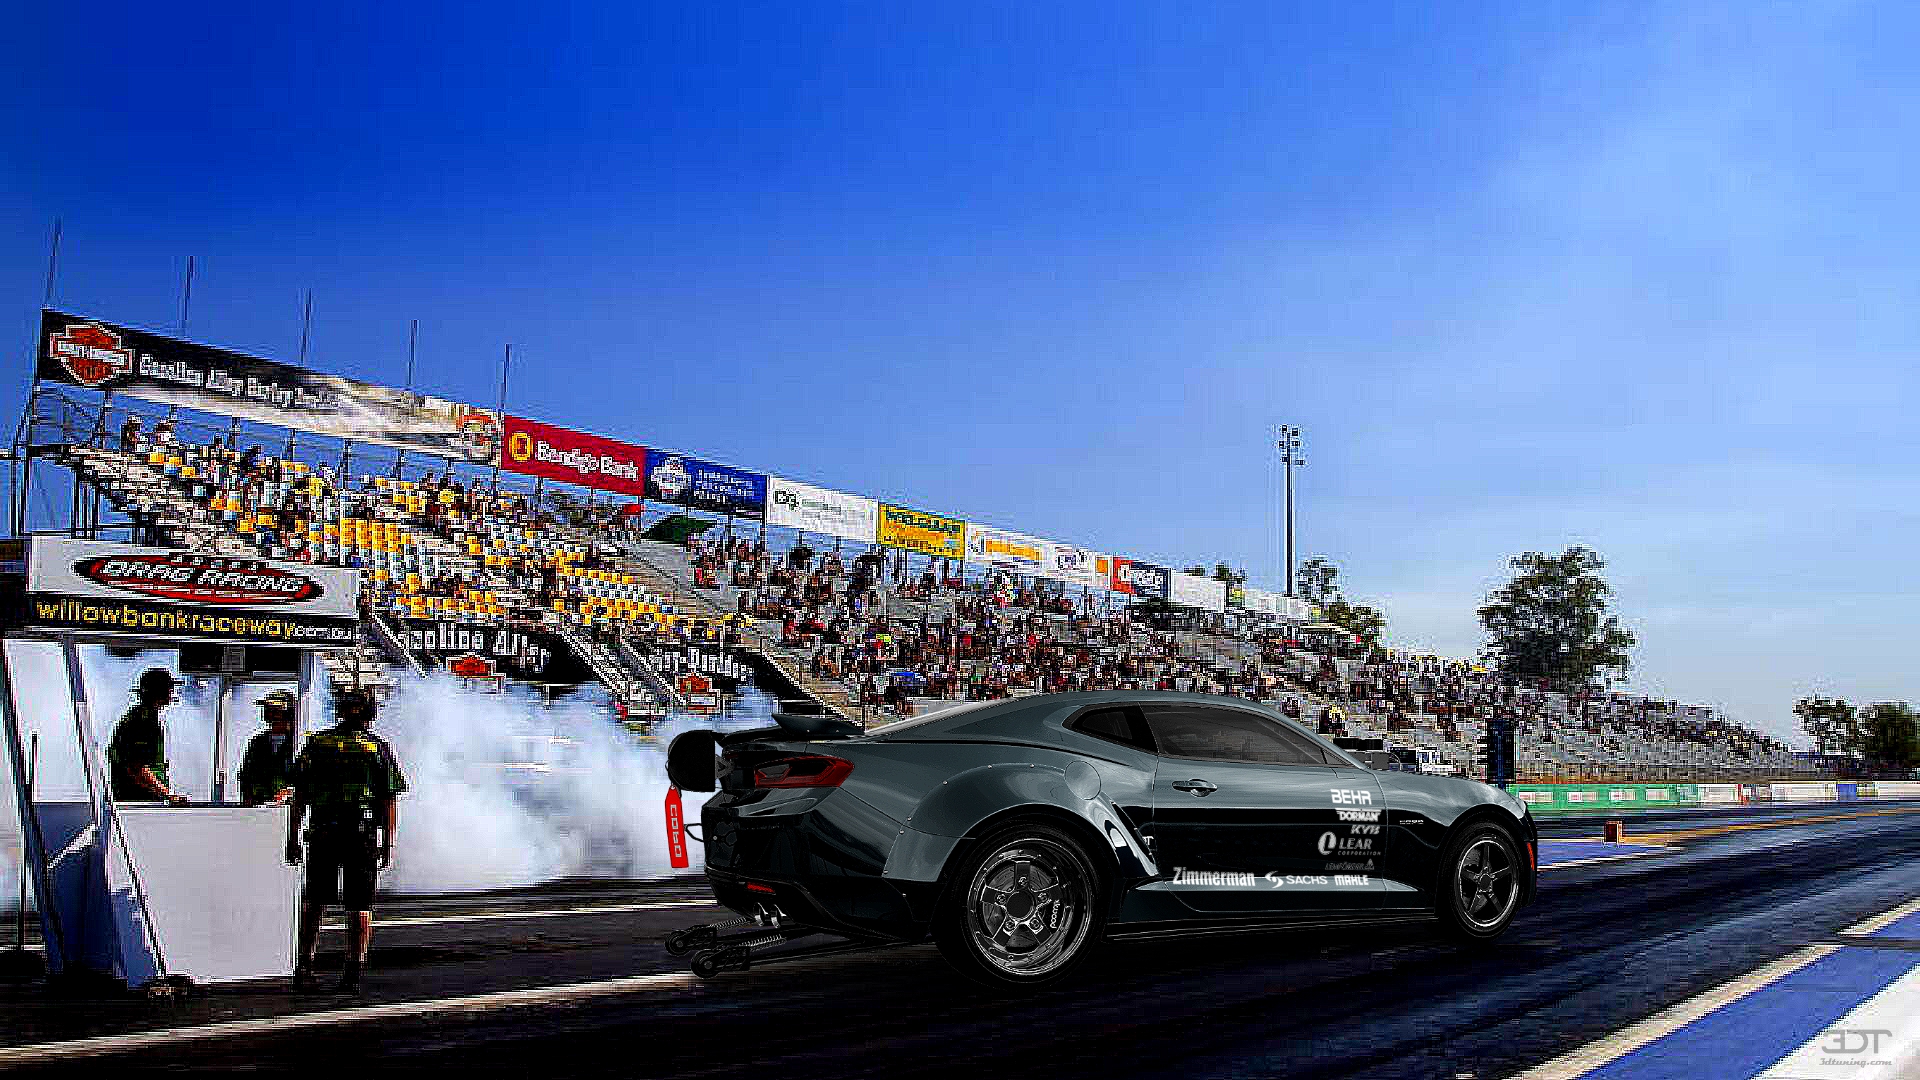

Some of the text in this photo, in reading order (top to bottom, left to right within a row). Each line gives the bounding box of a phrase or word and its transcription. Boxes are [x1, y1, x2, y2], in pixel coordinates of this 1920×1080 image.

[537, 440, 599, 474] Bendigo
[600, 456, 639, 482] Bank
[102, 562, 193, 582] DRAG
[197, 570, 305, 592] RACING
[1330, 788, 1372, 805] BEHR
[1336, 810, 1381, 822] DORMAN
[1350, 824, 1381, 835] KYB
[1339, 837, 1373, 850] LEAR
[1172, 866, 1369, 887] Zimmerman SACHS MAHLE
